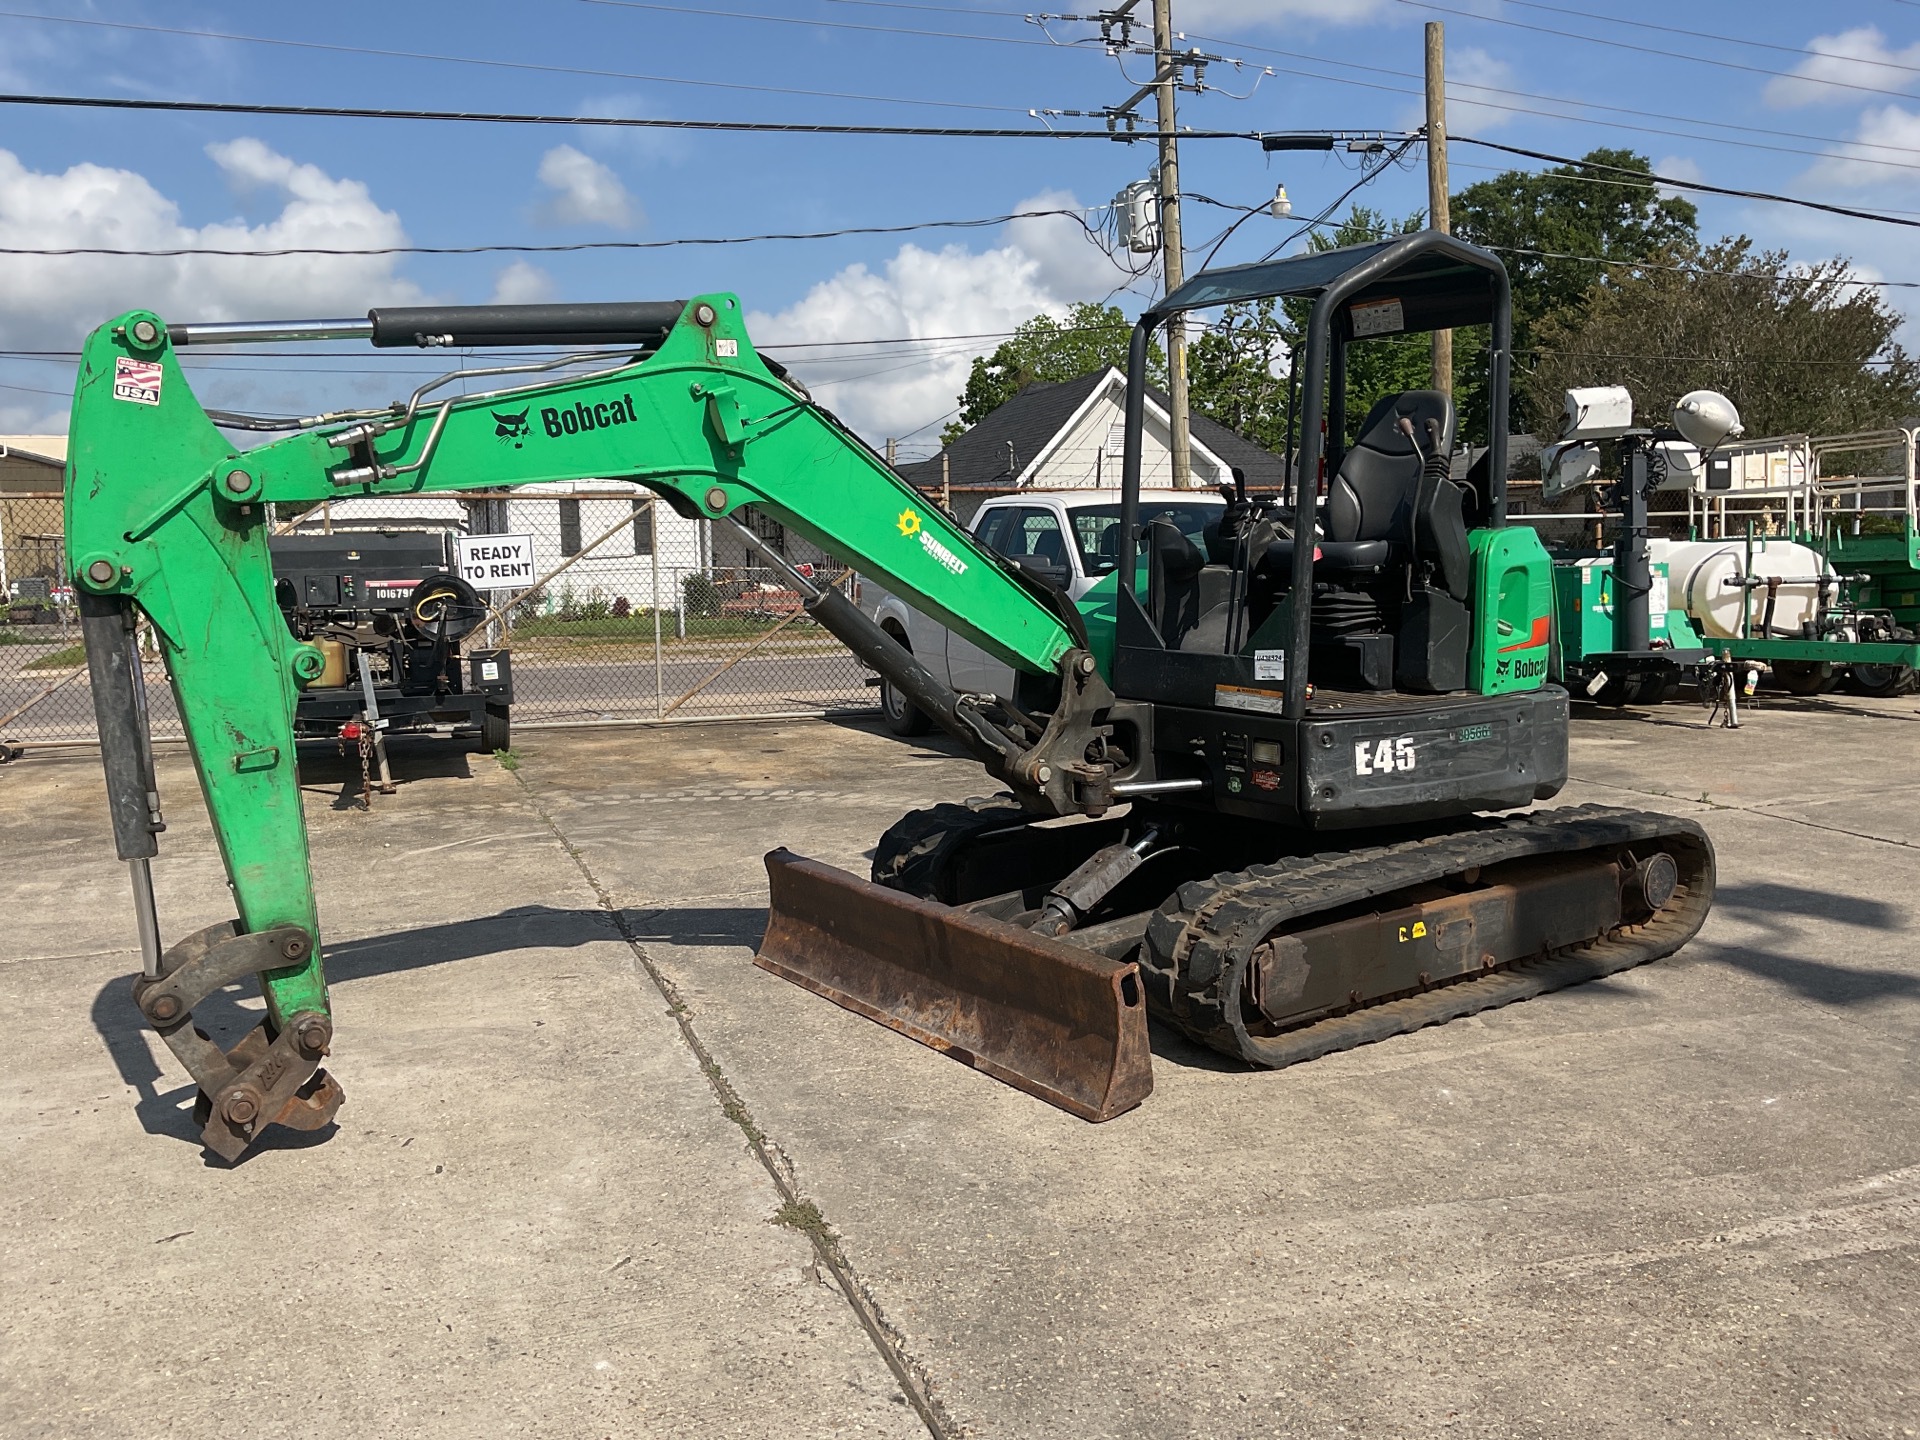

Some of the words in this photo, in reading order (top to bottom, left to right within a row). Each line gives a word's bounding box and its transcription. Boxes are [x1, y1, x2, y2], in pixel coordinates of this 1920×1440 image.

[117, 385, 156, 401] USA
[540, 393, 638, 438] Bobcat
[470, 545, 521, 561] READY
[919, 530, 968, 575] SUNBELT
[922, 545, 956, 575] RENTALS
[464, 565, 485, 579] TO
[490, 563, 531, 578] RENT
[1355, 737, 1415, 776] E45
